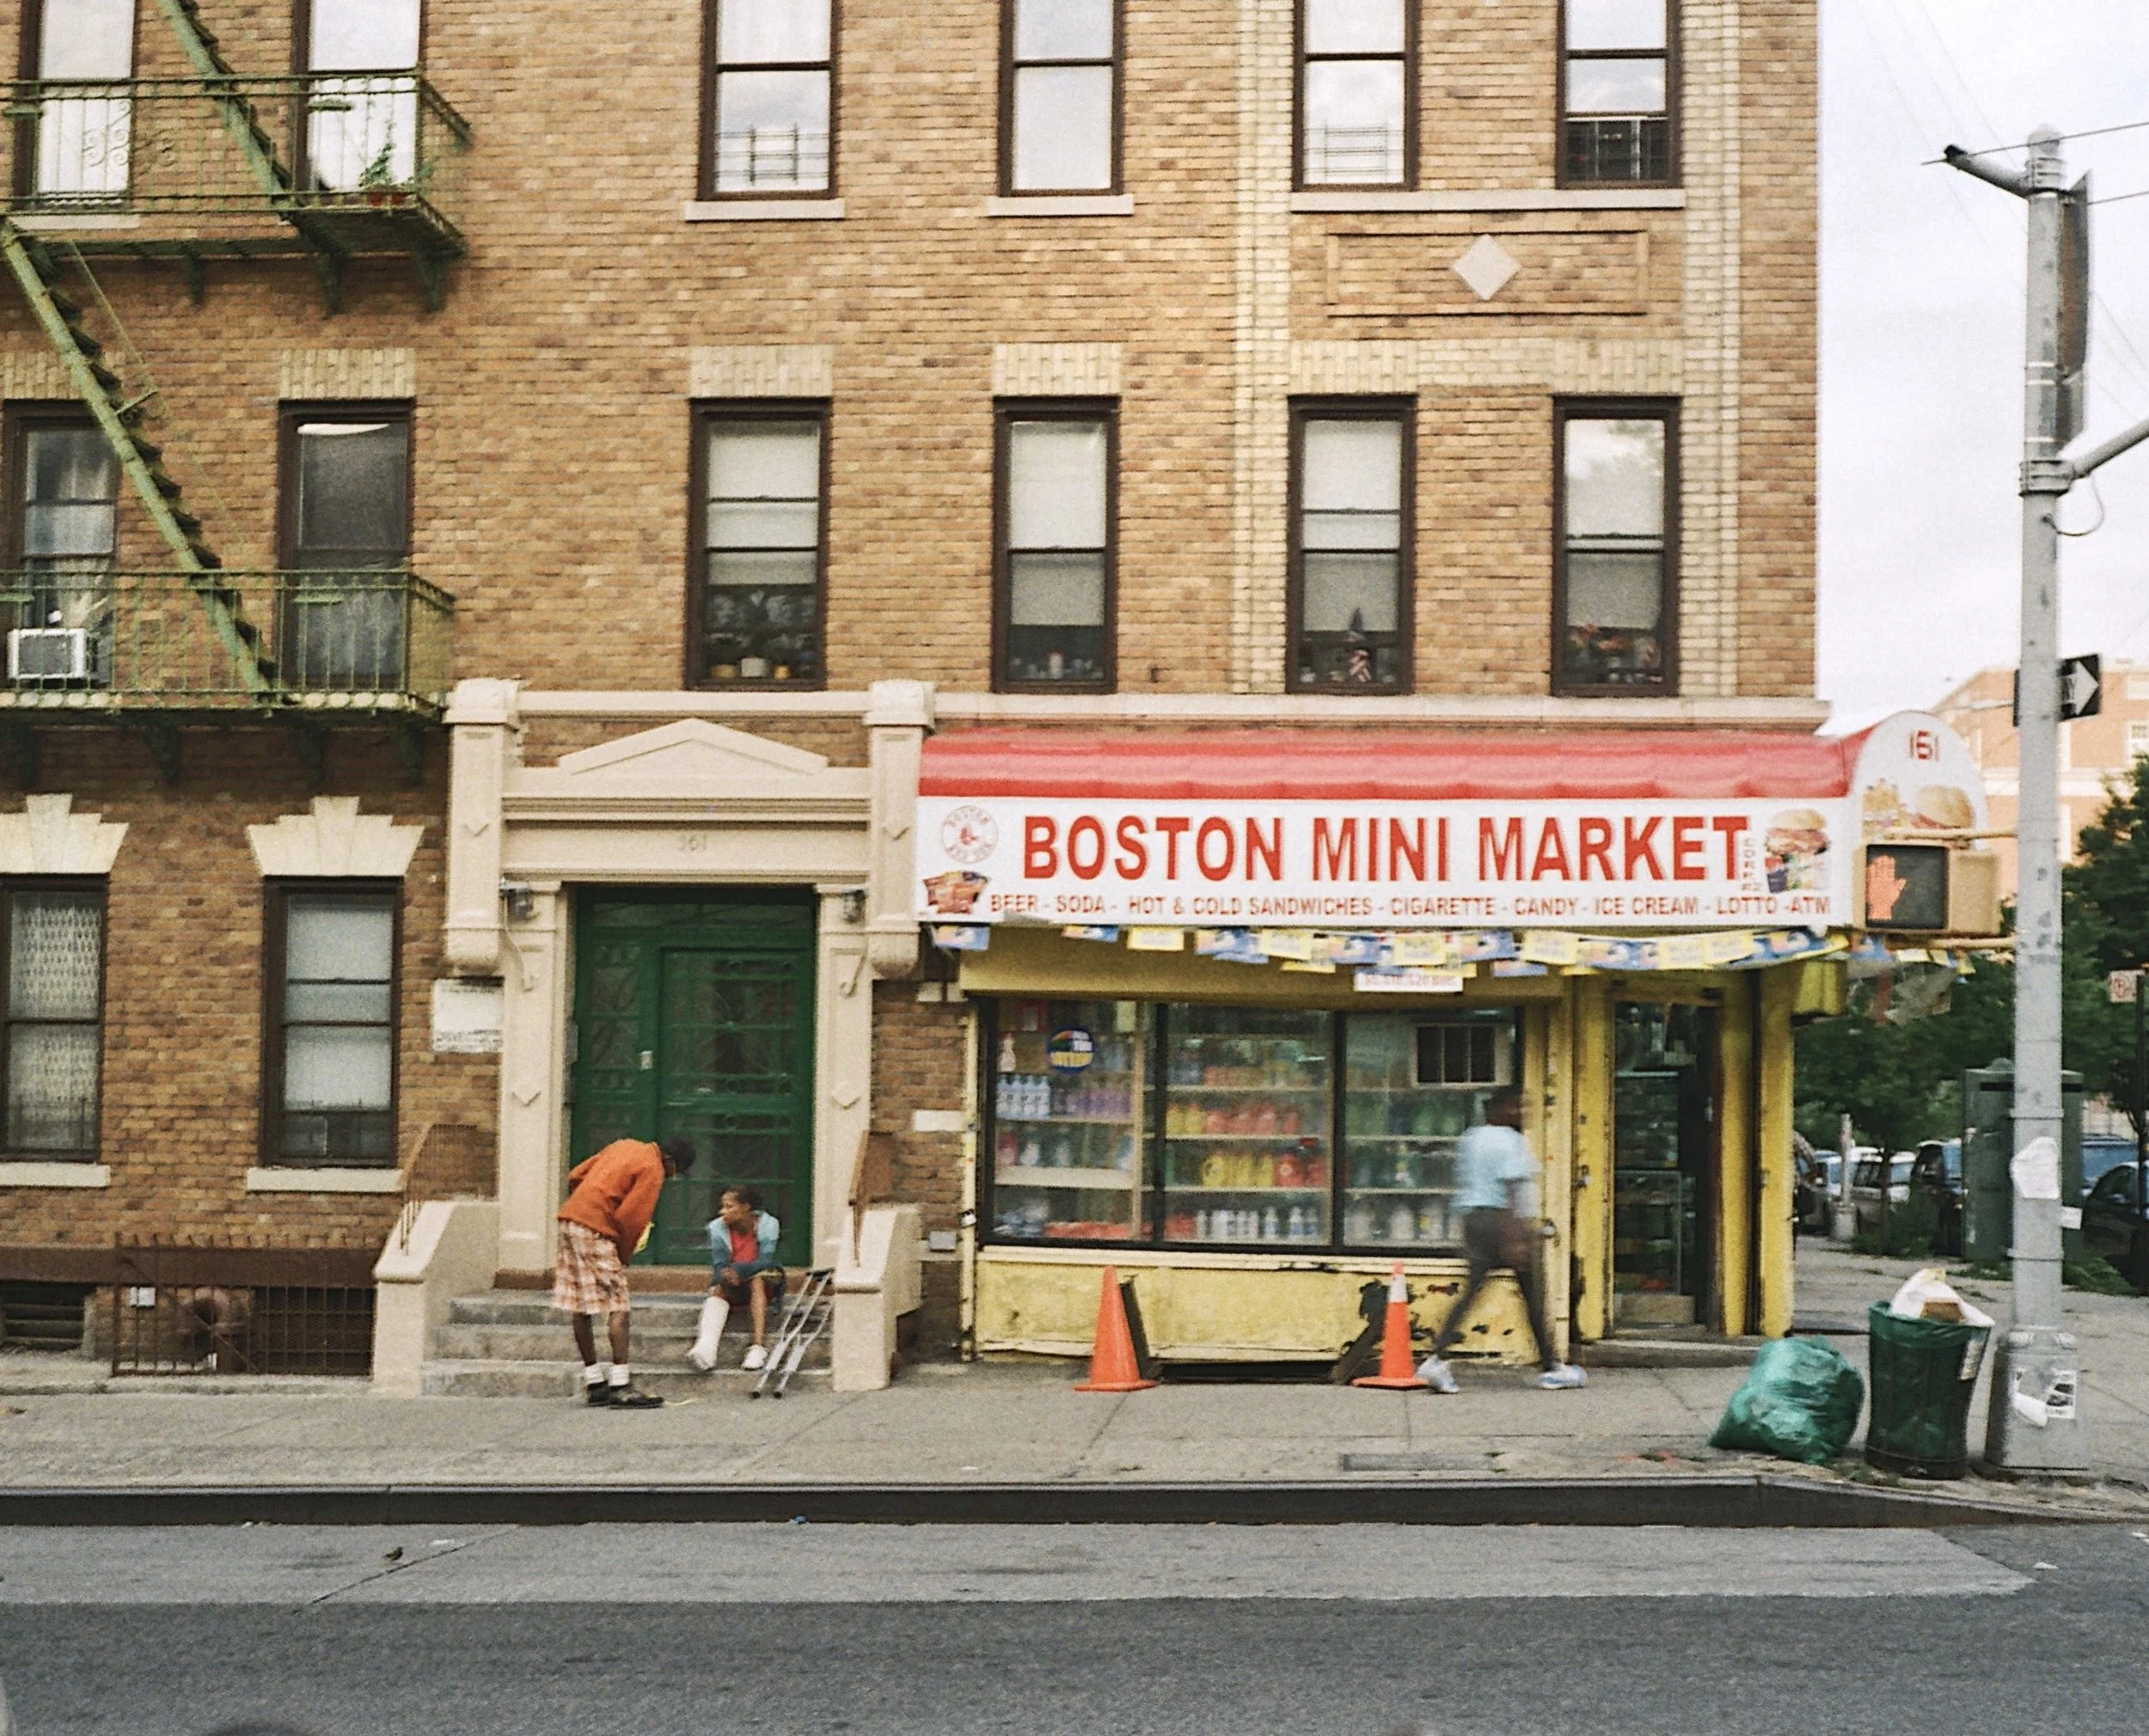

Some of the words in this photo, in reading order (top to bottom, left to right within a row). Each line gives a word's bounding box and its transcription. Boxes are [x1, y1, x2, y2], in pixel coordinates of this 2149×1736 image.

[1023, 815, 1283, 882] BOSTON
[1312, 816, 1448, 883] MINI
[1478, 815, 1748, 882] MARKET
[1055, 895, 1105, 914] SODA
[1128, 896, 1166, 915] HOT
[1172, 896, 1185, 915] &
[1192, 896, 1242, 915] COLD
[1249, 896, 1372, 916] SANDWICHES
[1390, 896, 1496, 916] CIGARETTE
[1514, 896, 1577, 916] CANDY
[1595, 896, 1625, 916] ICE
[1632, 896, 1699, 916] CREAM
[1717, 896, 1777, 916] LOTTO
